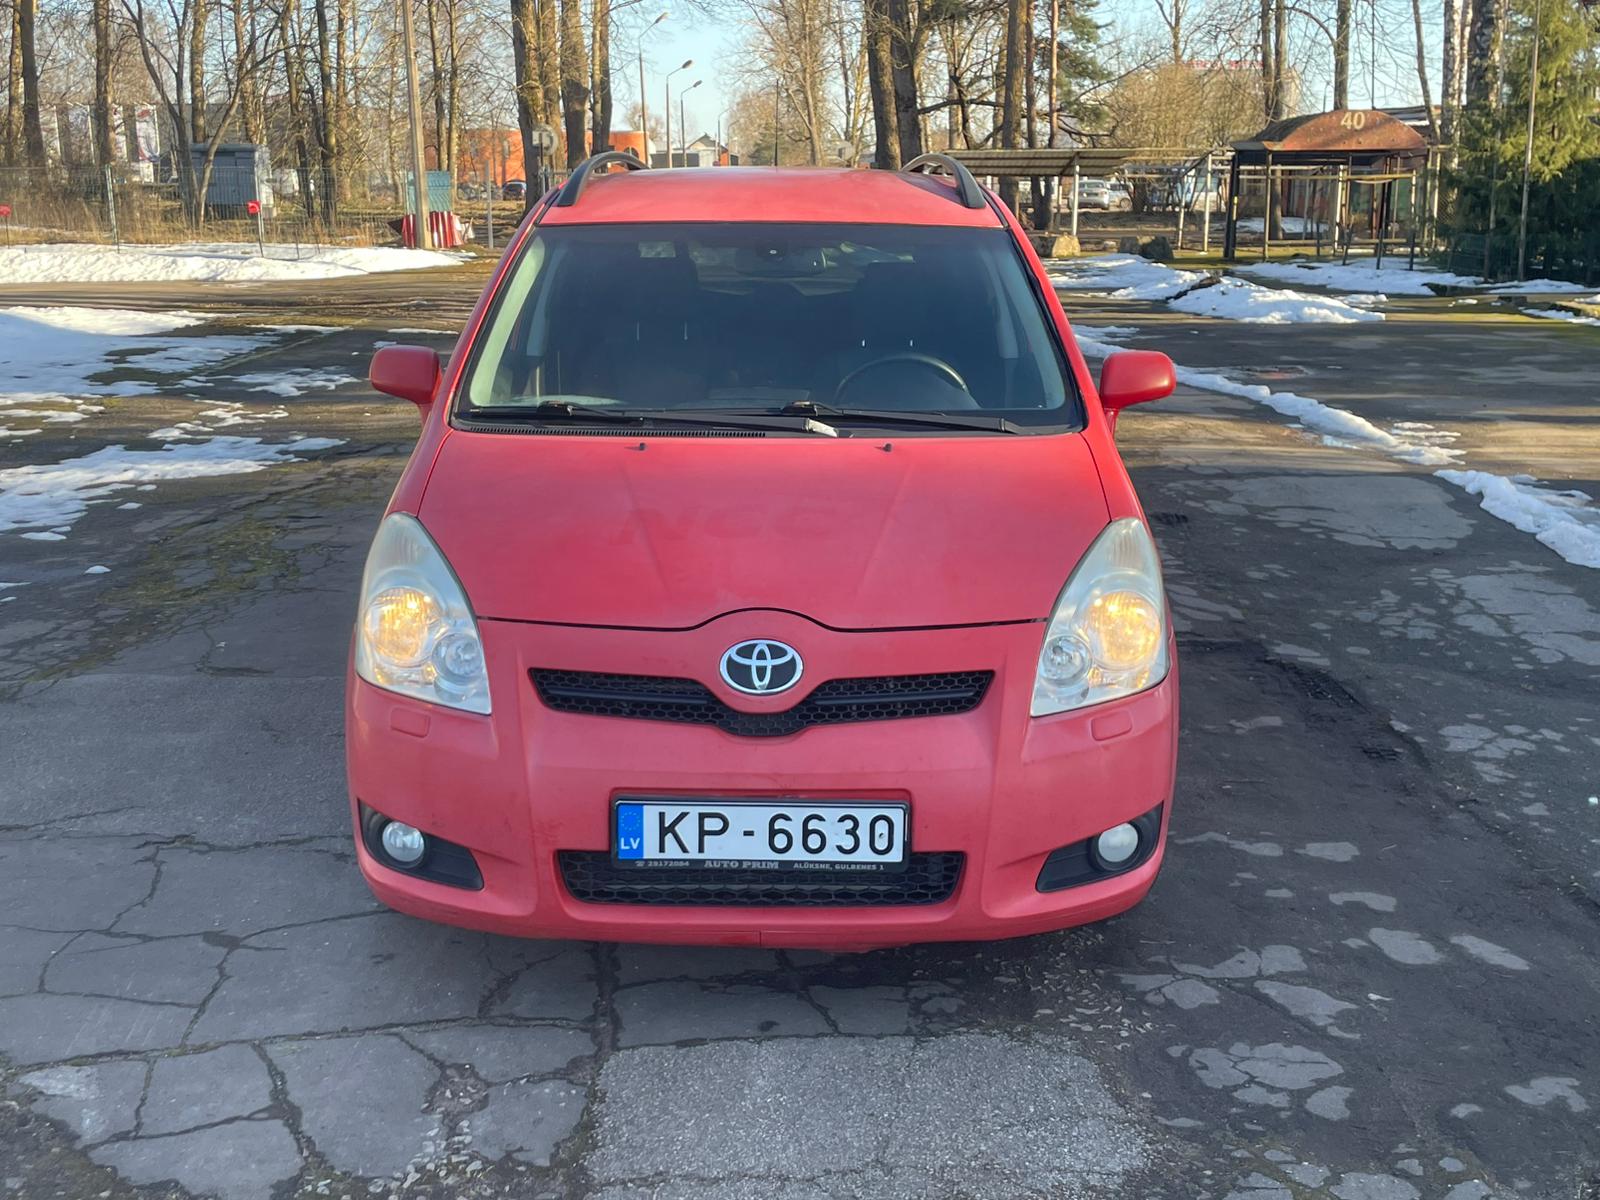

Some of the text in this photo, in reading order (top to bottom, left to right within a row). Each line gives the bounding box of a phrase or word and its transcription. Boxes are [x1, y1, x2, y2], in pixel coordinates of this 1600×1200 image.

[1340, 112, 1366, 130] 40
[620, 838, 641, 850] LV
[704, 860, 740, 869] AUTO
[742, 861, 779, 870] PRIM
